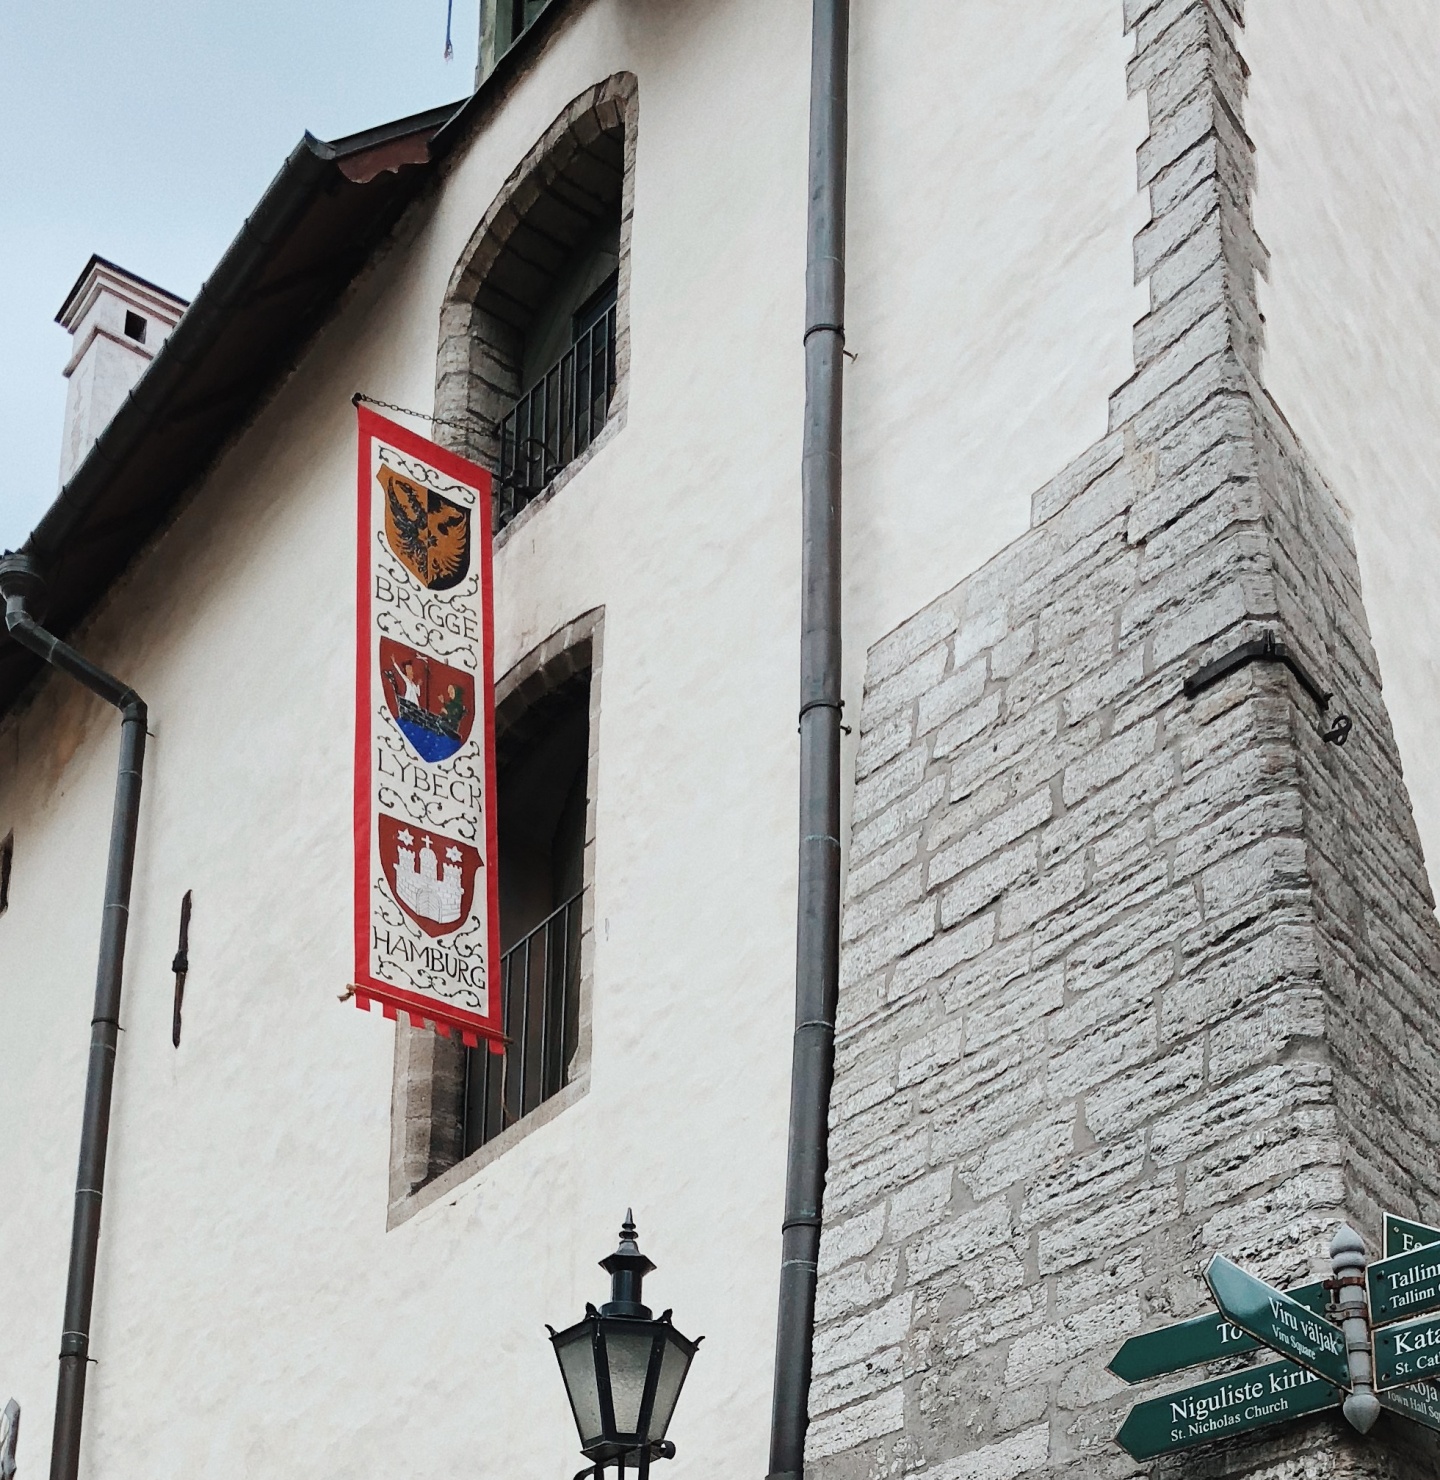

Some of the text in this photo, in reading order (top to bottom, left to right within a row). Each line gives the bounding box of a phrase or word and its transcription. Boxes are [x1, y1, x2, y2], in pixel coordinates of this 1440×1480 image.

[376, 575, 478, 642] BRYGGE
[378, 748, 482, 812] LYBECK
[372, 925, 485, 990] HAMBURG
[1389, 1287, 1435, 1309] Tallinn
[1268, 1296, 1339, 1356] Viru väljak
[1272, 1324, 1316, 1360] Viru Square
[1395, 1351, 1440, 1376] St. Cat
[1170, 1382, 1263, 1423] Niguliste
[1171, 1398, 1289, 1442] St. Nicholas Church
[1410, 1397, 1427, 1415] Hall
